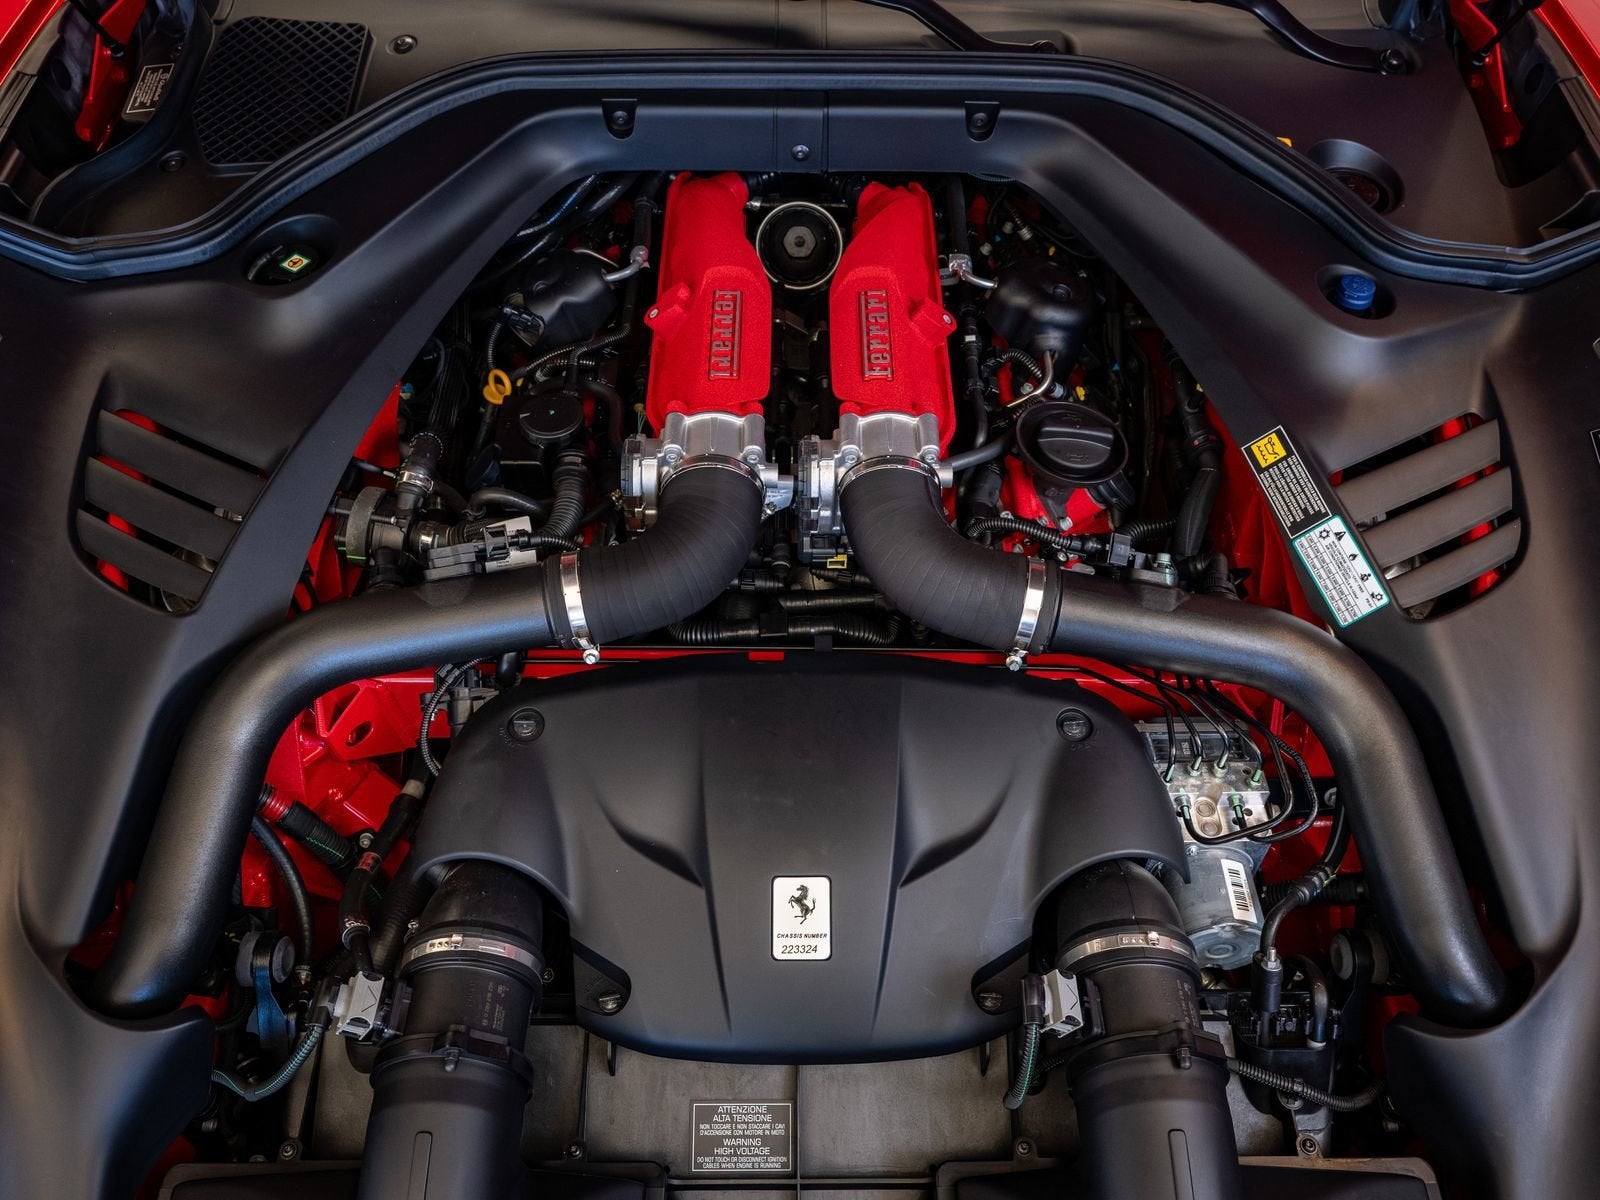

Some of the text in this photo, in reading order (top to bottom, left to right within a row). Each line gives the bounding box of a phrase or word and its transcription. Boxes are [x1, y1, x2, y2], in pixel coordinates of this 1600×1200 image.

[710, 288, 741, 377] Ferrari
[861, 289, 892, 378] Ferrari
[781, 944, 818, 954] 223324
